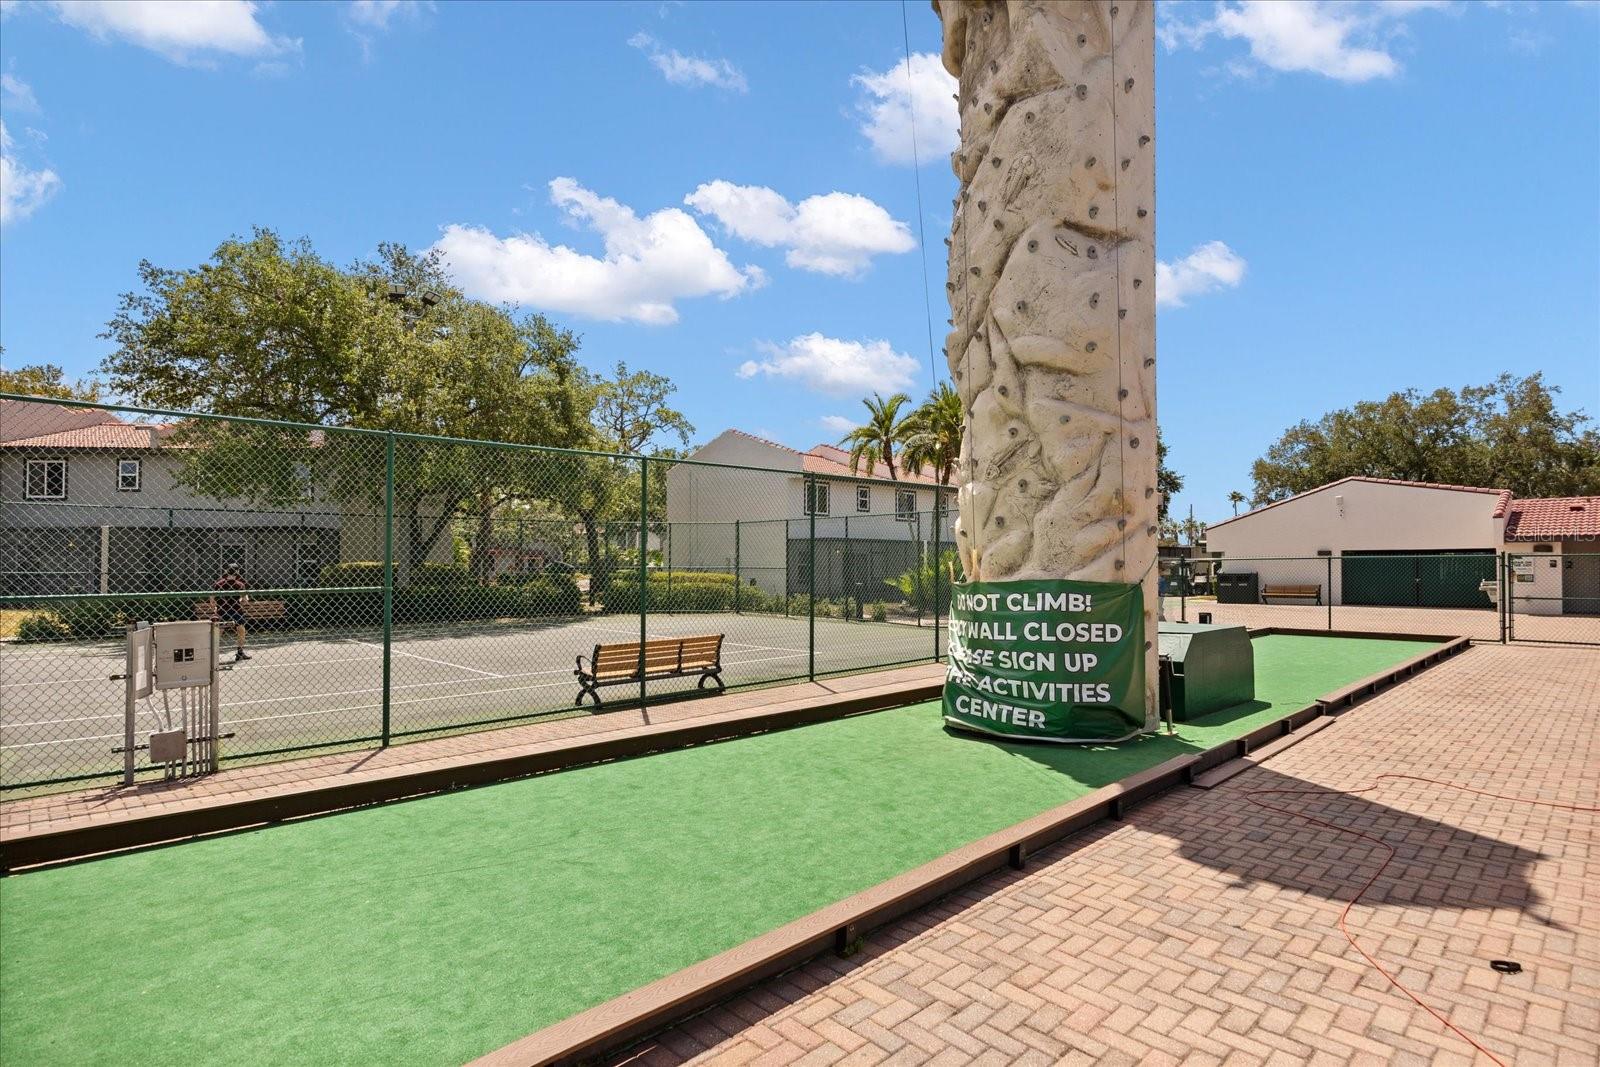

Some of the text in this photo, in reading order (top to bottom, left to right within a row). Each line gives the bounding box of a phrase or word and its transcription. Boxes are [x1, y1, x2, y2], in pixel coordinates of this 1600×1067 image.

[966, 593, 1000, 612] NOT
[1006, 592, 1092, 613] CLIMB!
[968, 620, 1018, 641] WALL
[1023, 621, 1123, 643] CLOSED
[998, 650, 1056, 672] SIGN
[1064, 652, 1098, 673] UP
[976, 674, 1111, 703] ACTIVITIES
[955, 694, 1046, 729] CENTER
